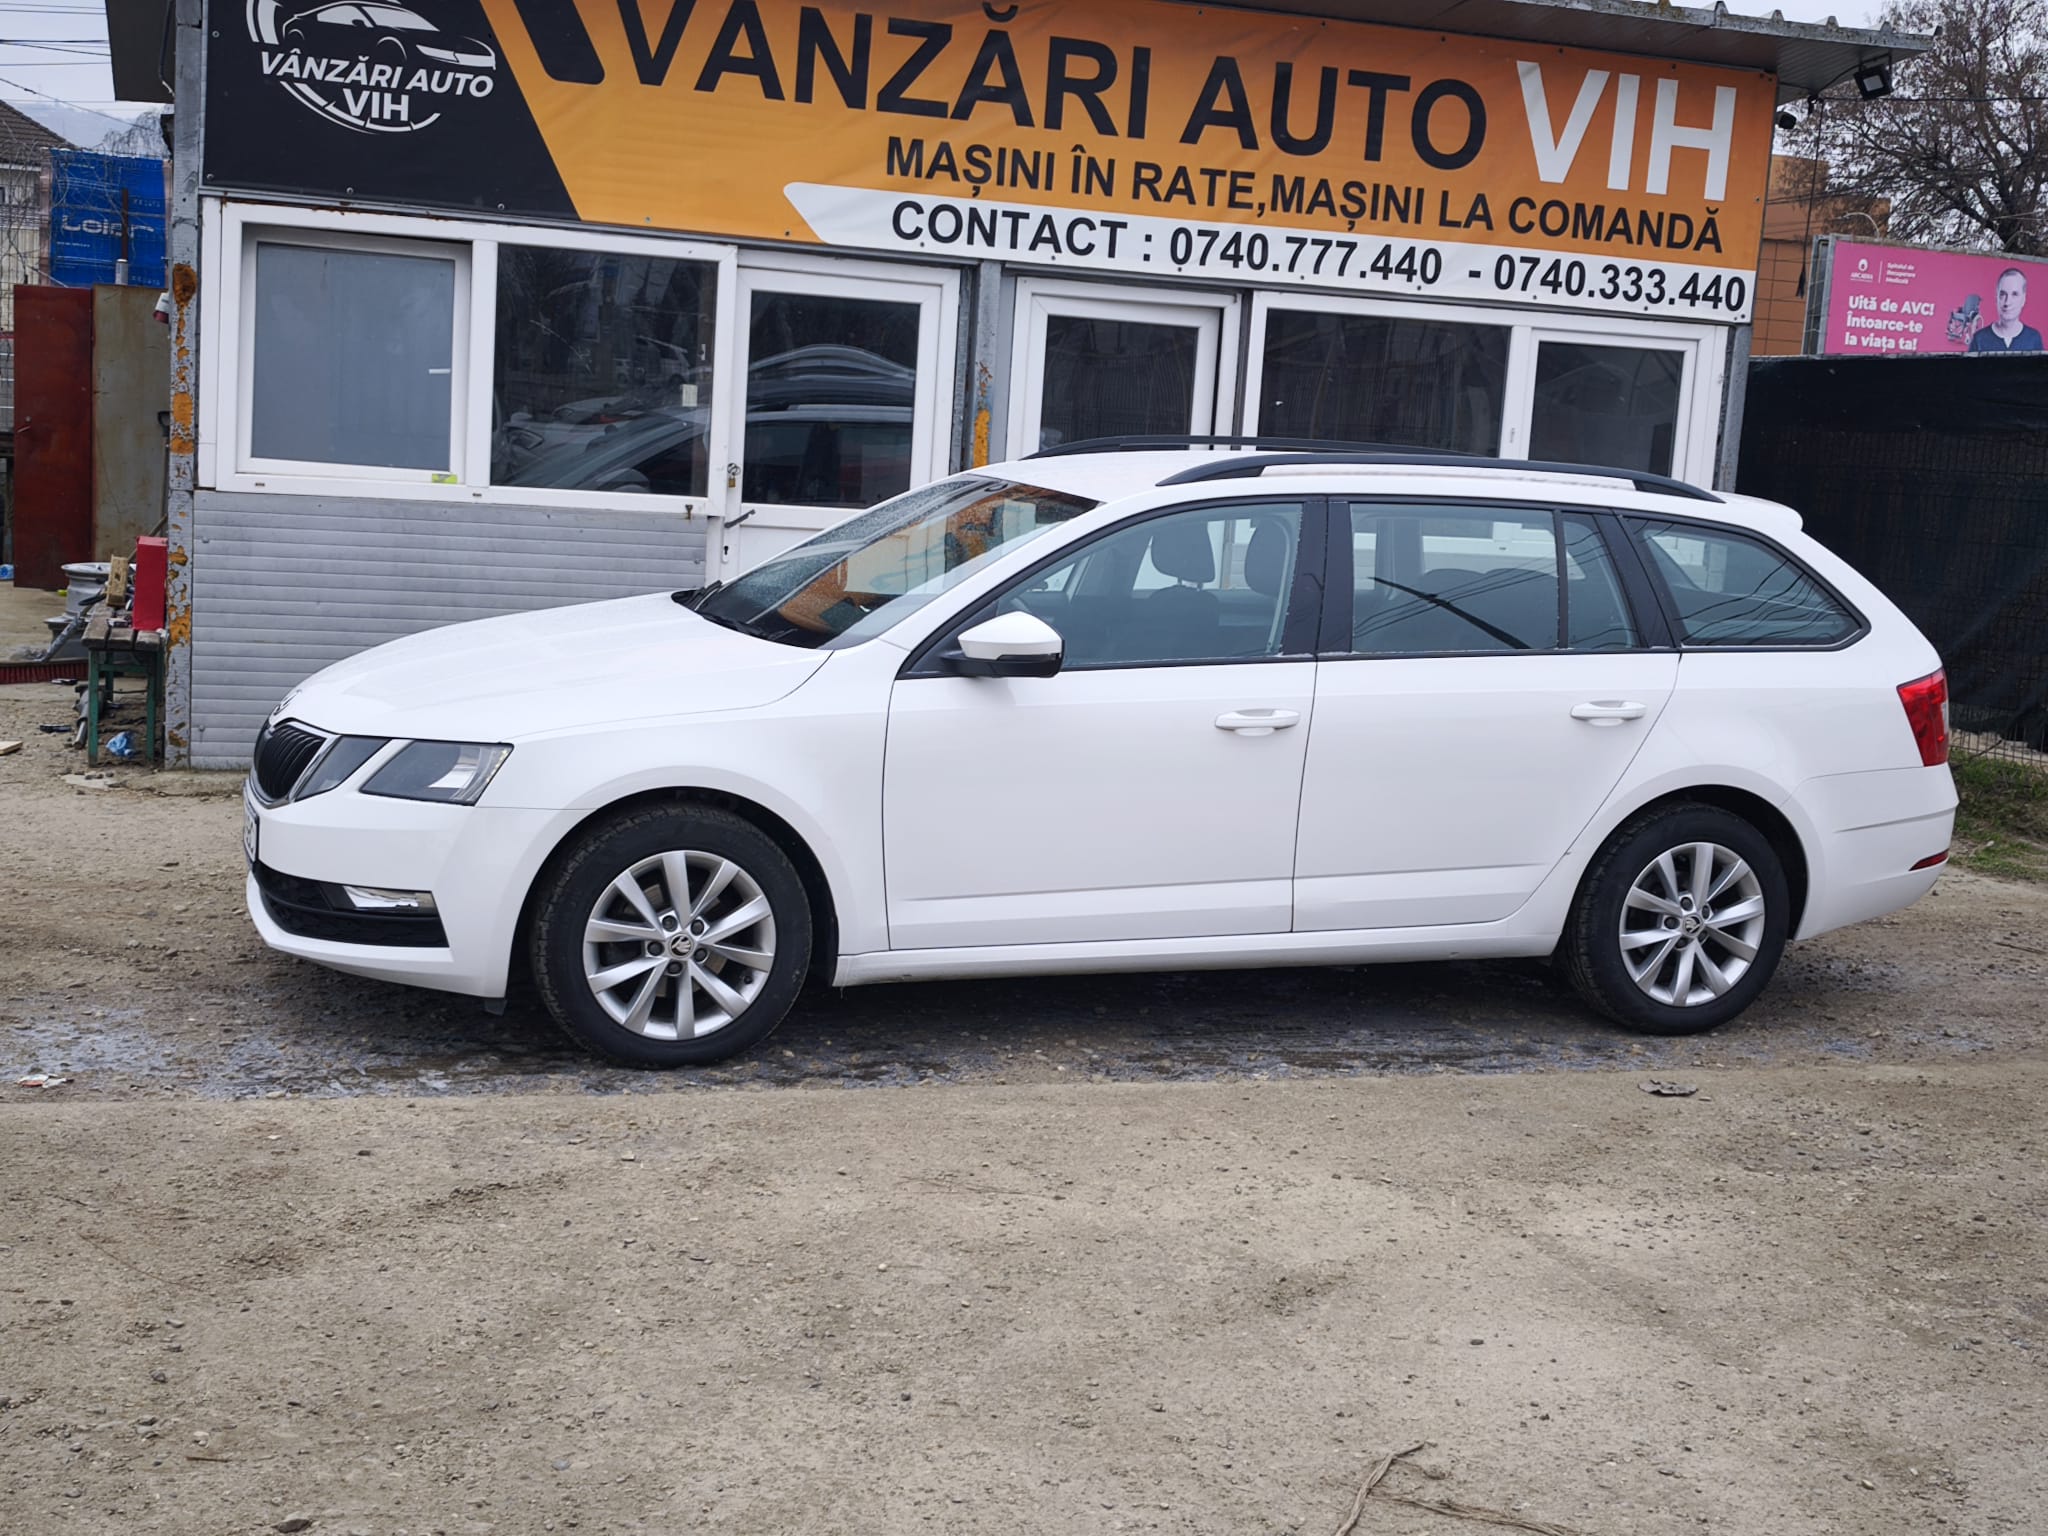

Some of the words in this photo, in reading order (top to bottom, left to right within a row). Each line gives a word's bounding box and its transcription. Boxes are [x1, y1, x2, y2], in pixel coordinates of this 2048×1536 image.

[261, 48, 403, 89] VÂNZĂRI
[405, 68, 495, 98] AUTO
[342, 87, 410, 122] VIH
[1179, 55, 1488, 171] AUTO
[1516, 60, 1738, 202] VIH
[886, 136, 1056, 198] MAȘINI
[1070, 144, 1116, 198] ÎN
[1438, 190, 1495, 231] LA
[1508, 196, 1724, 254] COMANDĂ
[891, 200, 1129, 259] CONTACT
[1169, 227, 1443, 285] 0740.777.440
[1494, 253, 1747, 312] 0740.333.440
[1846, 310, 1923, 333] Întoarce-te
[1848, 294, 1877, 311] Uită
[1880, 298, 1898, 313] de
[1900, 300, 1935, 316] AVC!
[1844, 331, 1858, 346] la
[1861, 332, 1896, 353] viața
[1899, 337, 1918, 351] ta!
